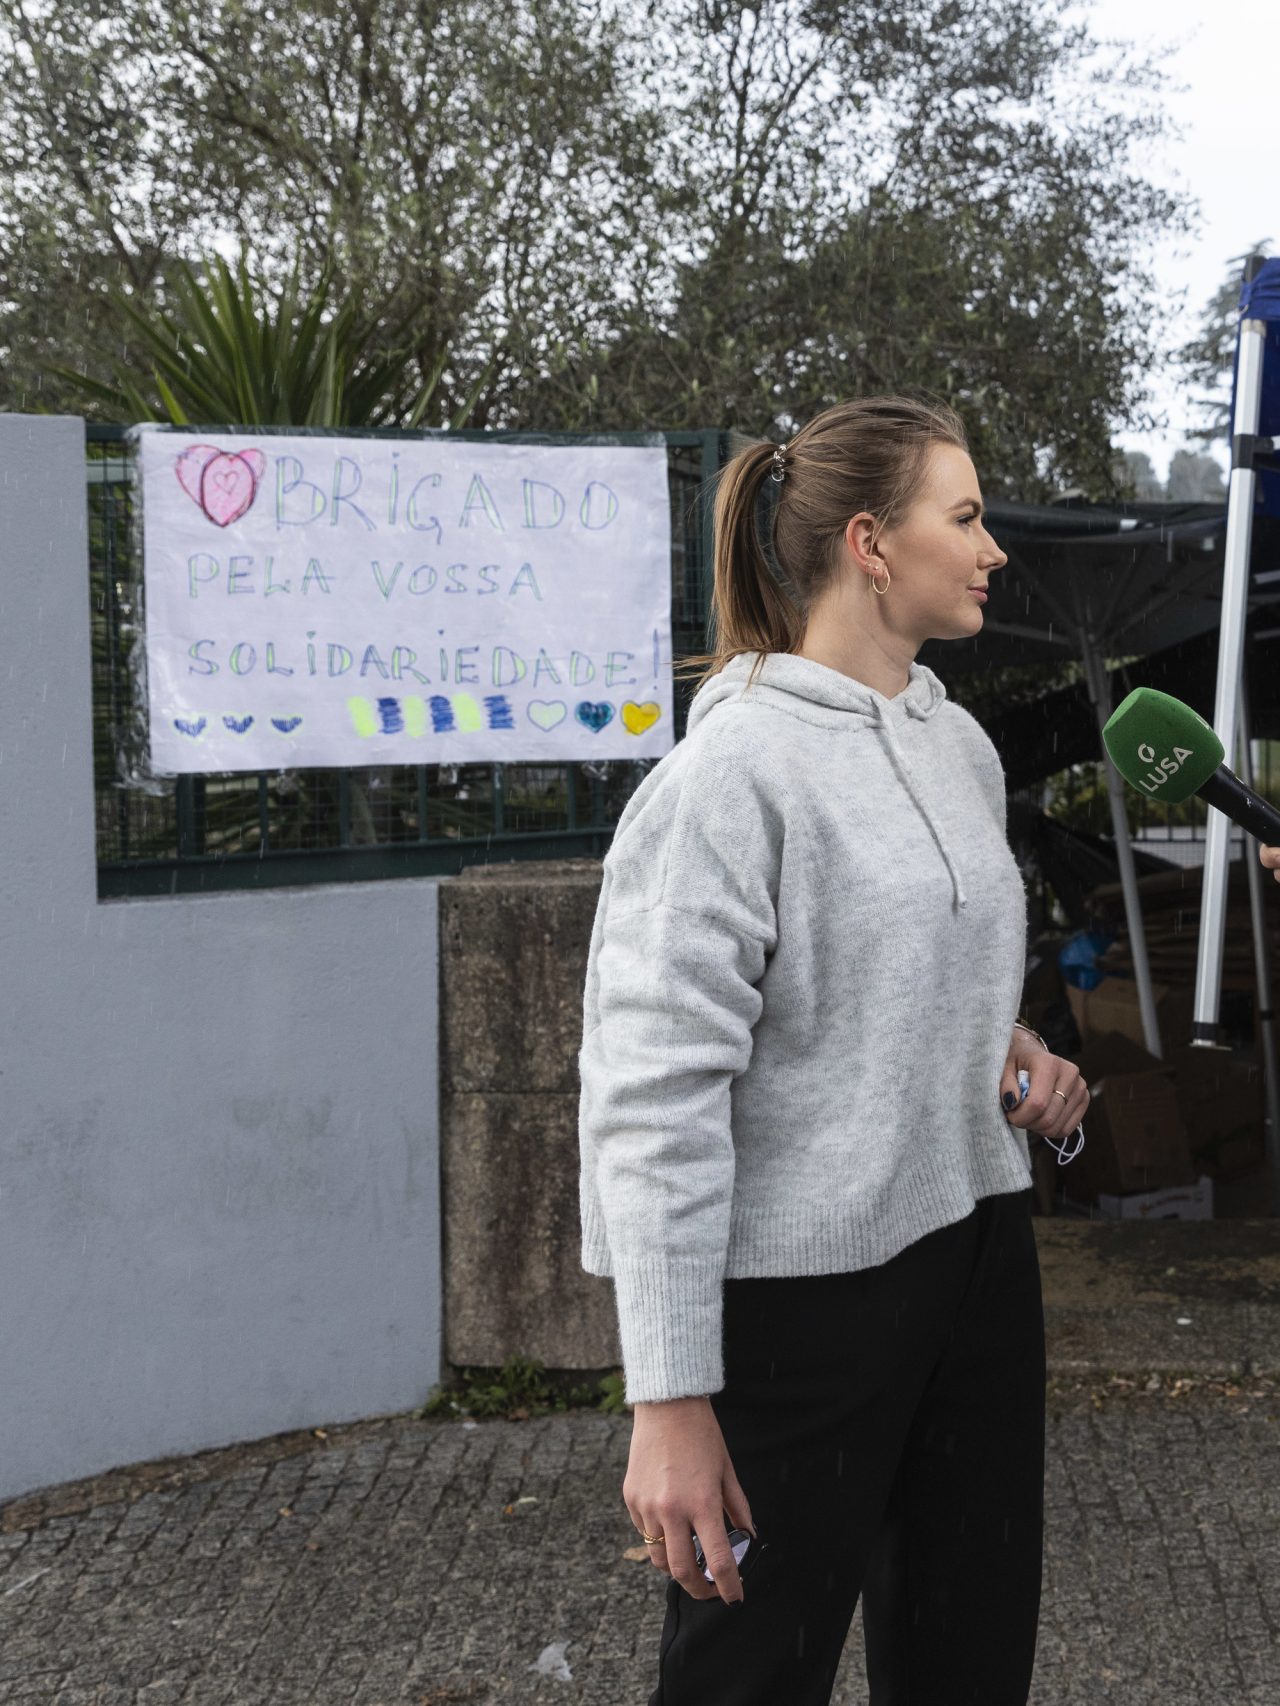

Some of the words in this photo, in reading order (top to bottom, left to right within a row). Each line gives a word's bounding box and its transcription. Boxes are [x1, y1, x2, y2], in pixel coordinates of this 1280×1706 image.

[188, 552, 335, 598] PELA
[370, 560, 543, 600] VOSSA
[1139, 747, 1193, 792] LUSA
